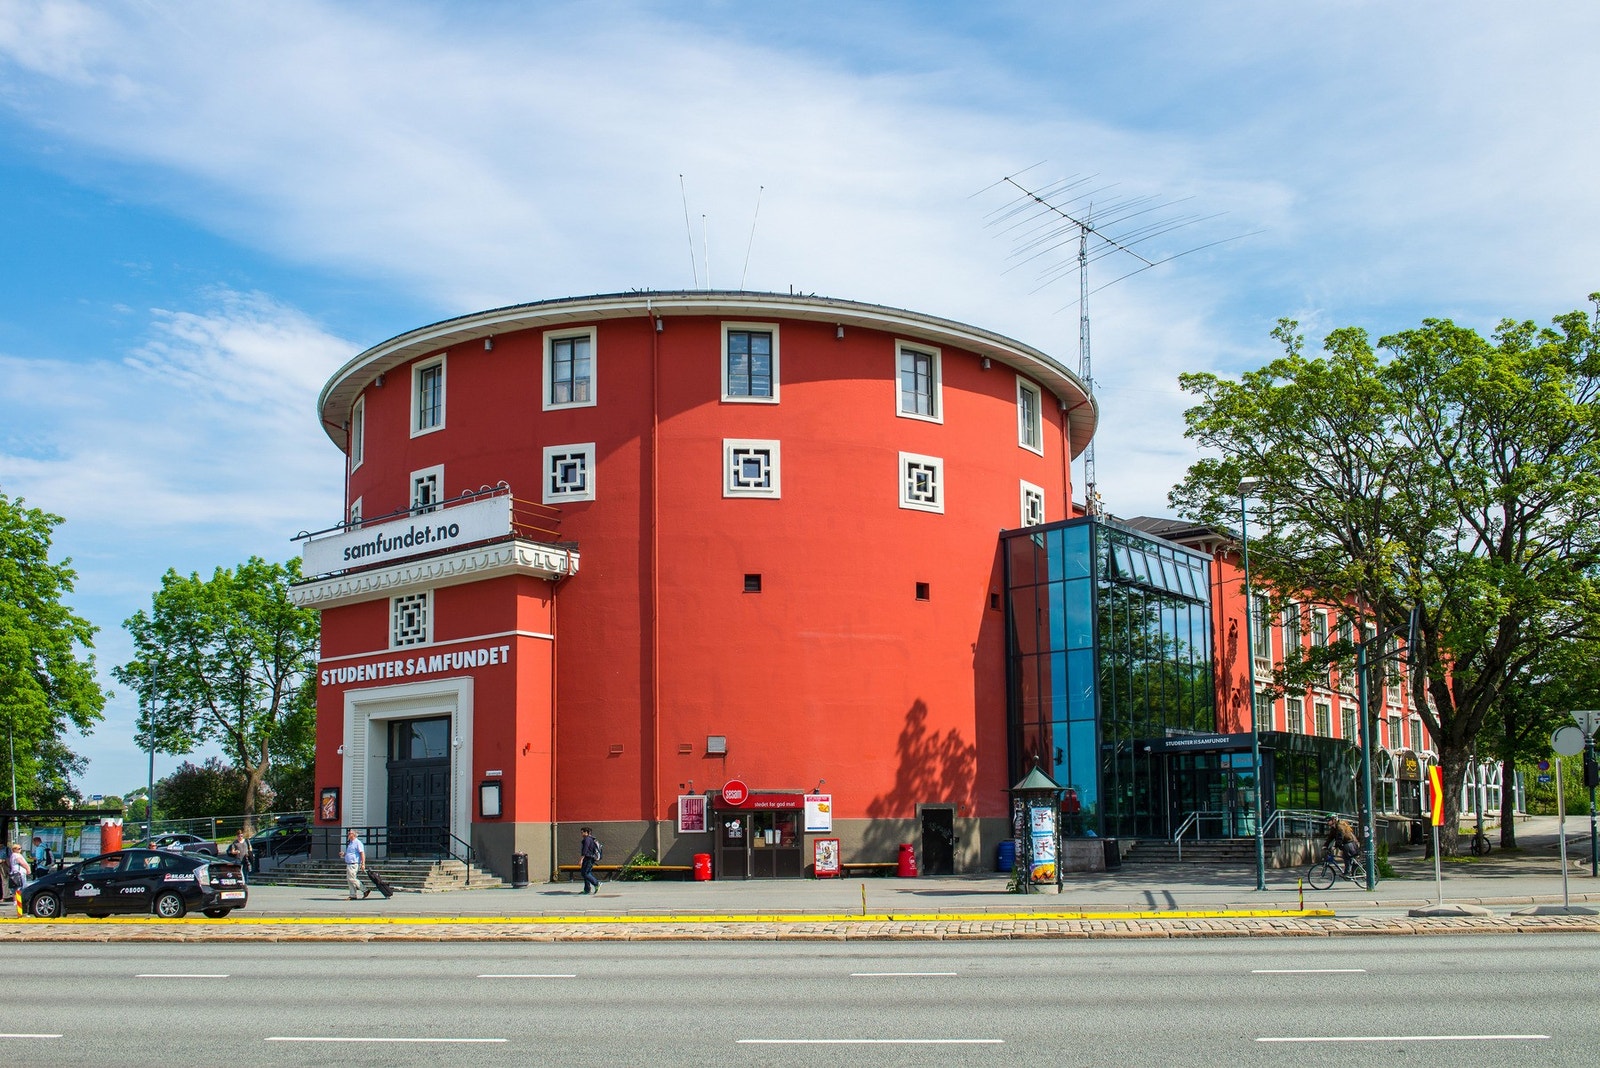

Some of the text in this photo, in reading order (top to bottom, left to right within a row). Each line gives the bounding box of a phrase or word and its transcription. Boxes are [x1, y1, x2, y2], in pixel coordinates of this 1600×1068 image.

[344, 523, 459, 561] samfundet.no
[321, 645, 509, 686] STUDENTERSAMFUNDET
[776, 801, 785, 809] god
